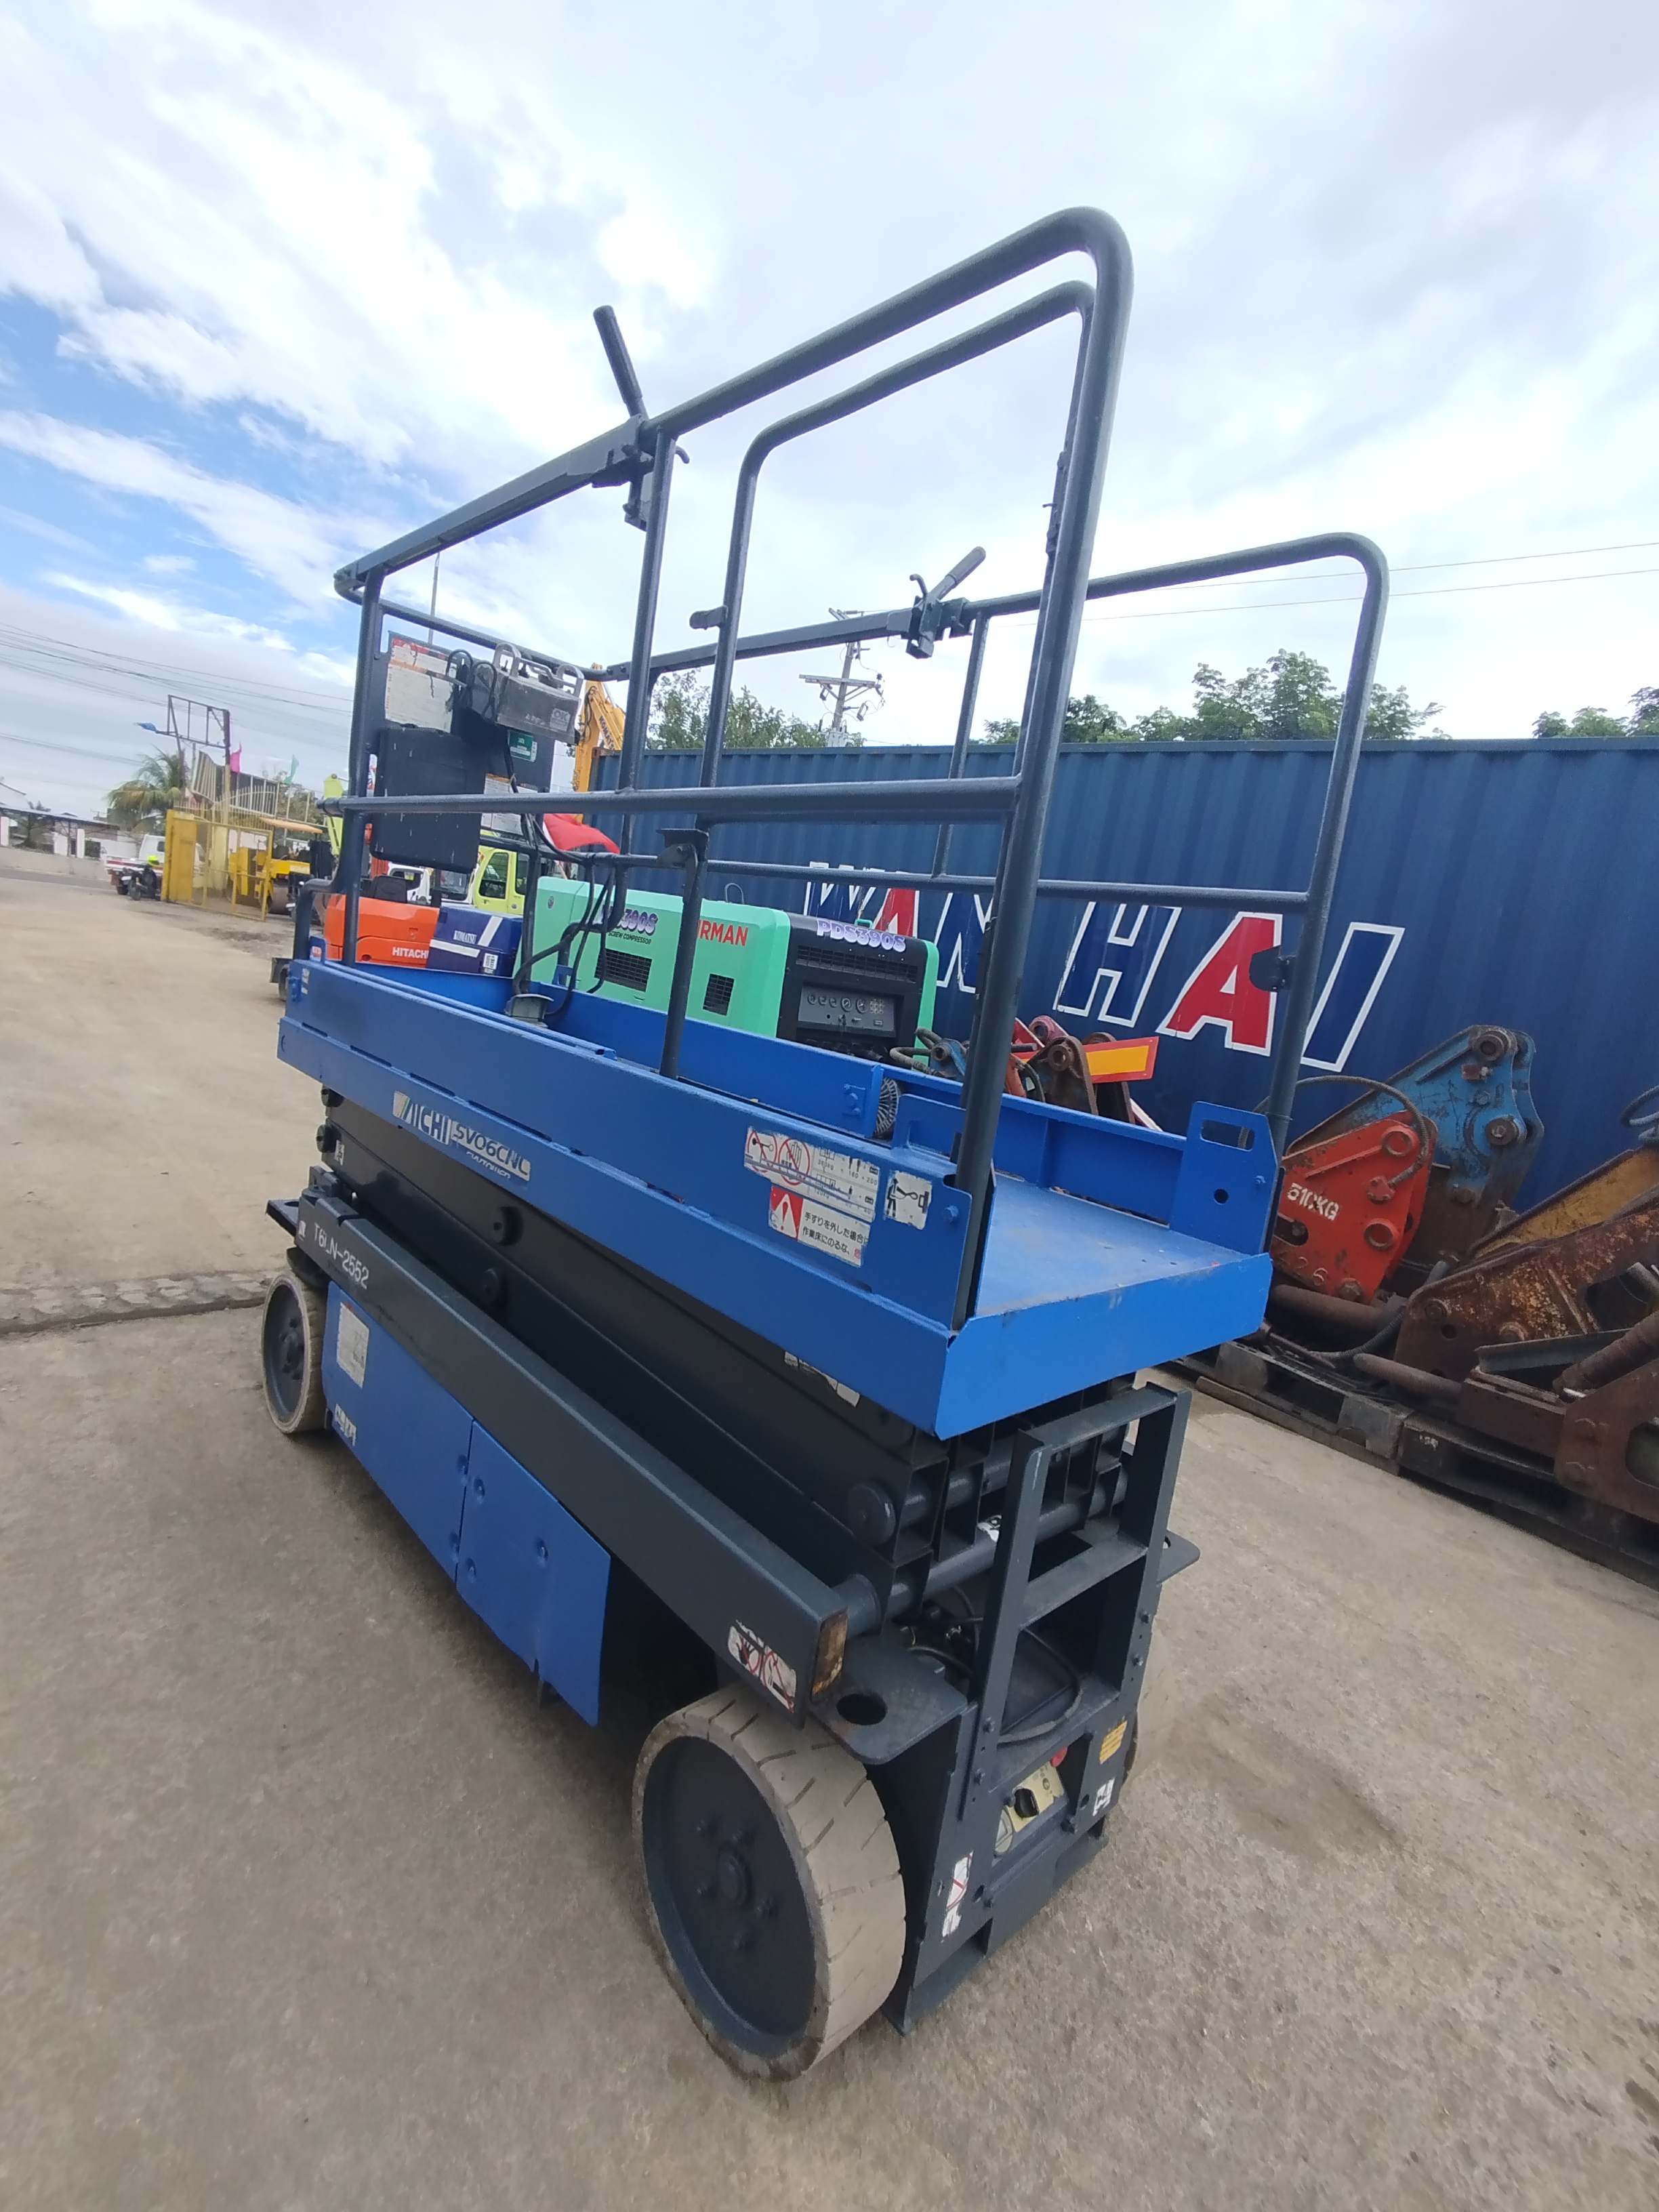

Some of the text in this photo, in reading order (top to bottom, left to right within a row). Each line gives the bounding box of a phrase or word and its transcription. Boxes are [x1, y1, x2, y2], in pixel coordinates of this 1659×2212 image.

[453, 930, 477, 945] KOMATSU
[623, 934, 651, 945] COMPRESSOR
[817, 919, 906, 952] PDS390S
[1052, 901, 1406, 1073] HAI
[402, 1102, 451, 1145] AICHI
